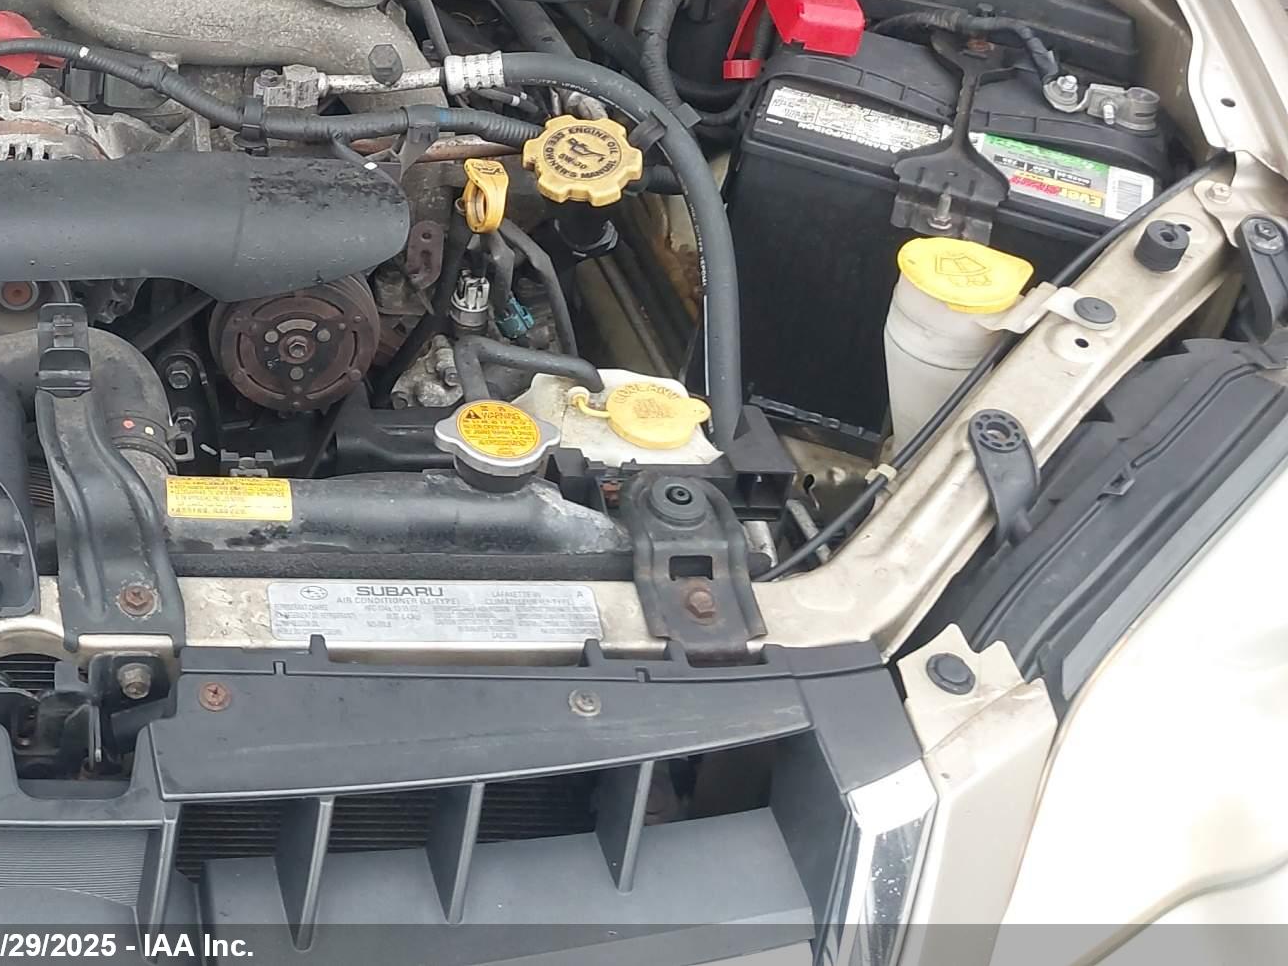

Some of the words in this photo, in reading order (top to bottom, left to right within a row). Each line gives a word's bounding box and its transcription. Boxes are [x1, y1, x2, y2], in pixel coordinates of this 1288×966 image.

[548, 132, 565, 146] SEE
[568, 127, 608, 141] ENGINE
[607, 141, 618, 154] OIL
[545, 147, 578, 178] OWNER'S
[558, 153, 588, 169] 5W-30
[580, 160, 617, 178] MANUAL
[356, 586, 444, 597] SUBARU
[336, 596, 353, 604] AIR
[354, 597, 418, 605] CONDITIONER
